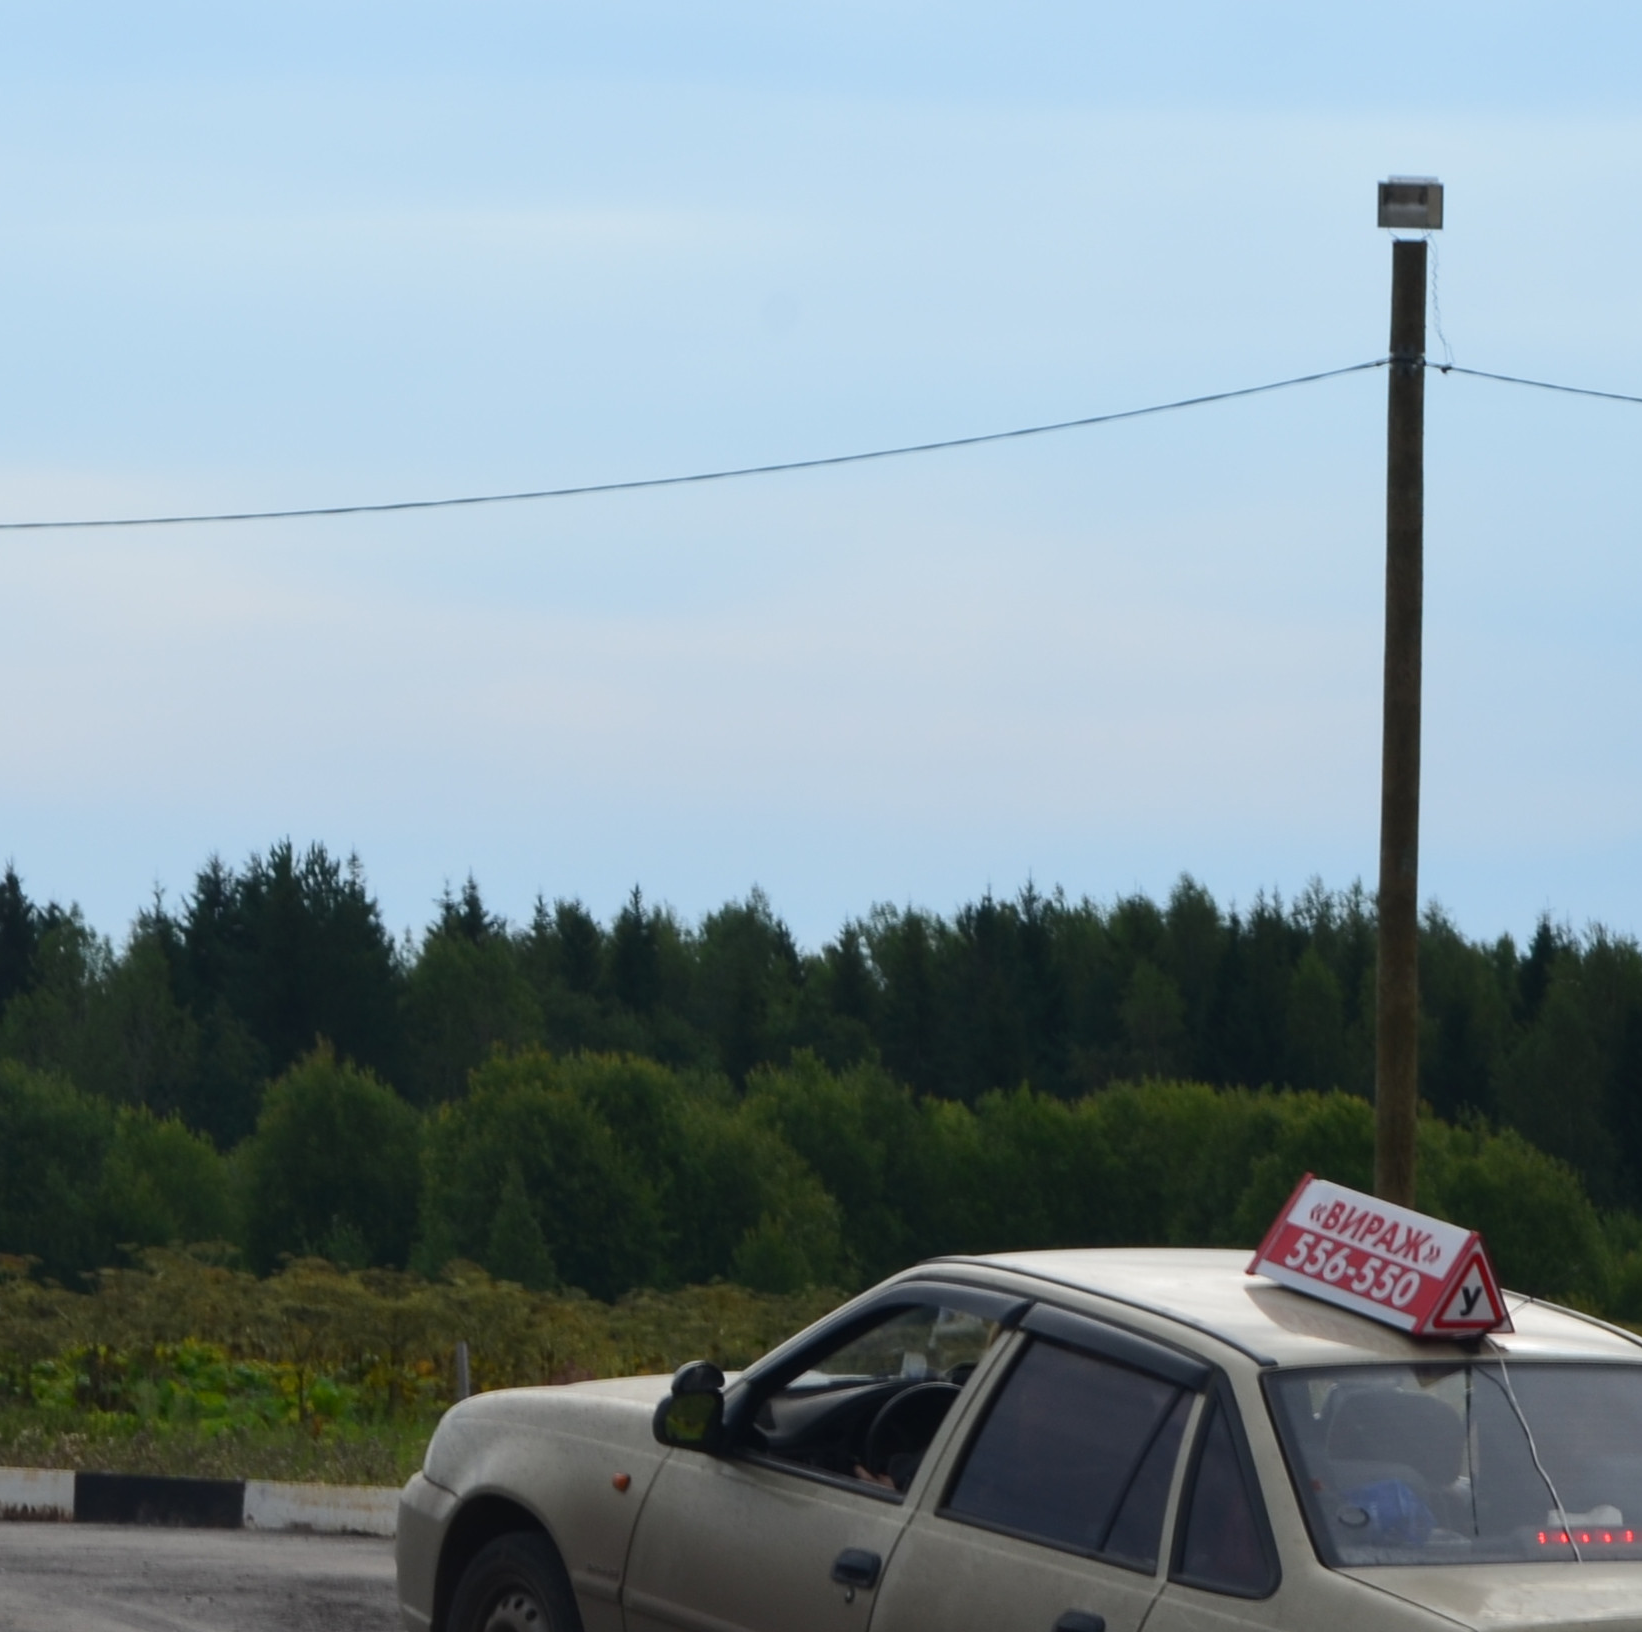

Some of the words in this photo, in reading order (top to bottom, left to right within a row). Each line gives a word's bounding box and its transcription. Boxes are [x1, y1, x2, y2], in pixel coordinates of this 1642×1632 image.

[1310, 1200, 1441, 1264] «ВИРАЖ»
[1285, 1232, 1421, 1308] 556-550
[1460, 1286, 1482, 1316] У
